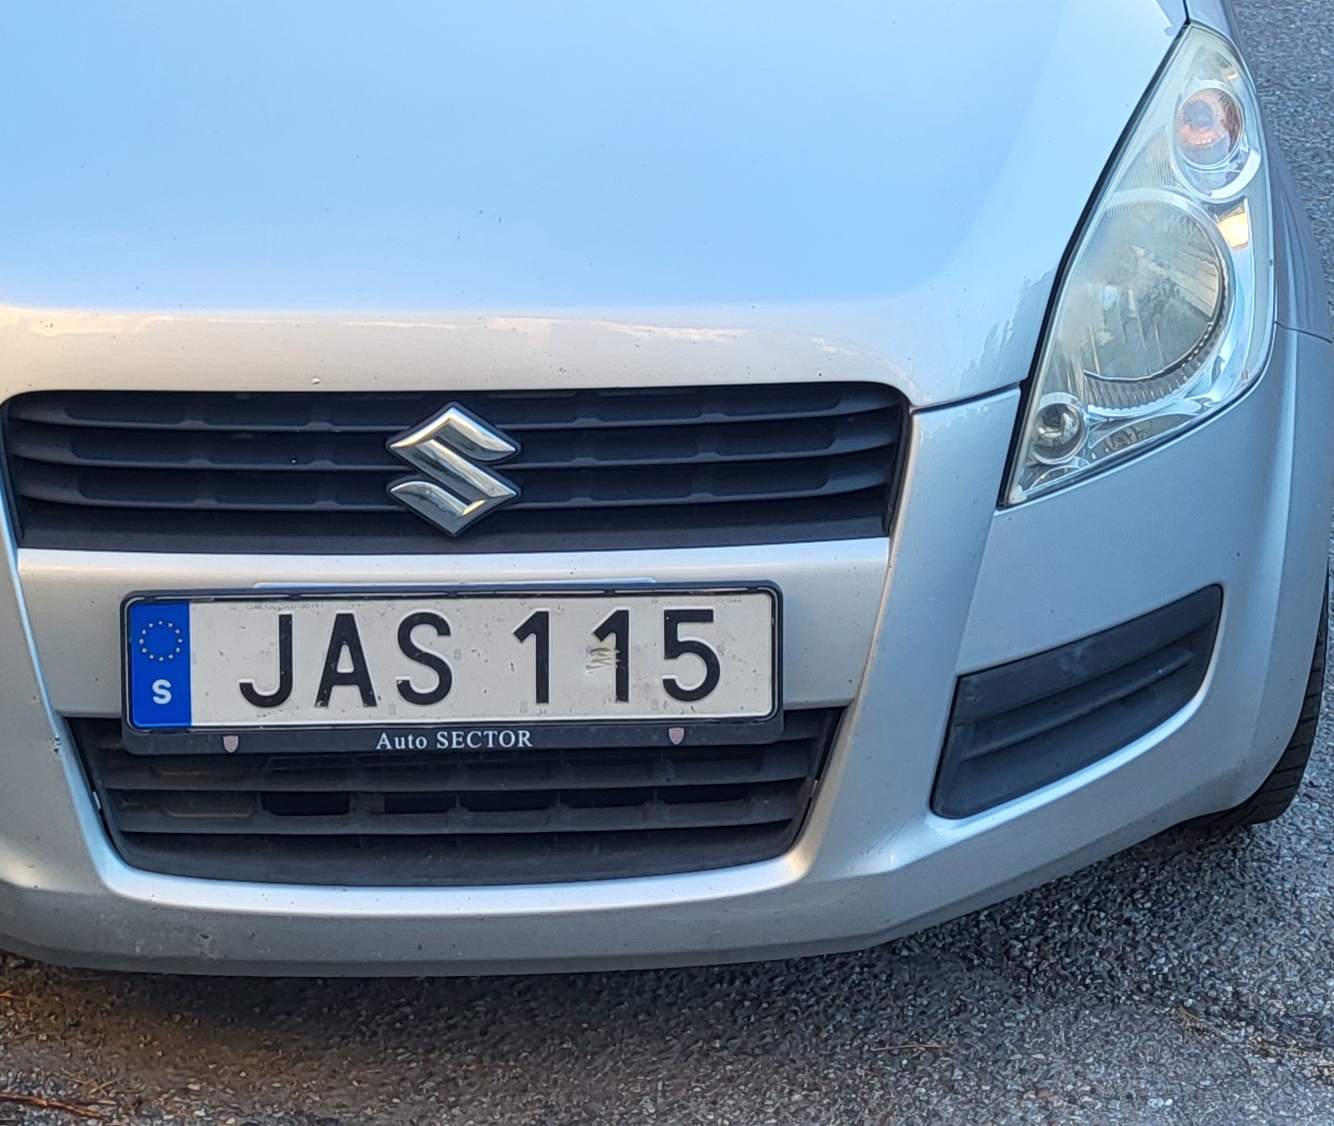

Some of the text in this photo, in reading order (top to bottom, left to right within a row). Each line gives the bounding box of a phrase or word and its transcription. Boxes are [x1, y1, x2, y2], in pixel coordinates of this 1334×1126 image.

[239, 609, 721, 708] JAS 115
[152, 679, 172, 705] S
[376, 730, 534, 750] Auto SECTOR
